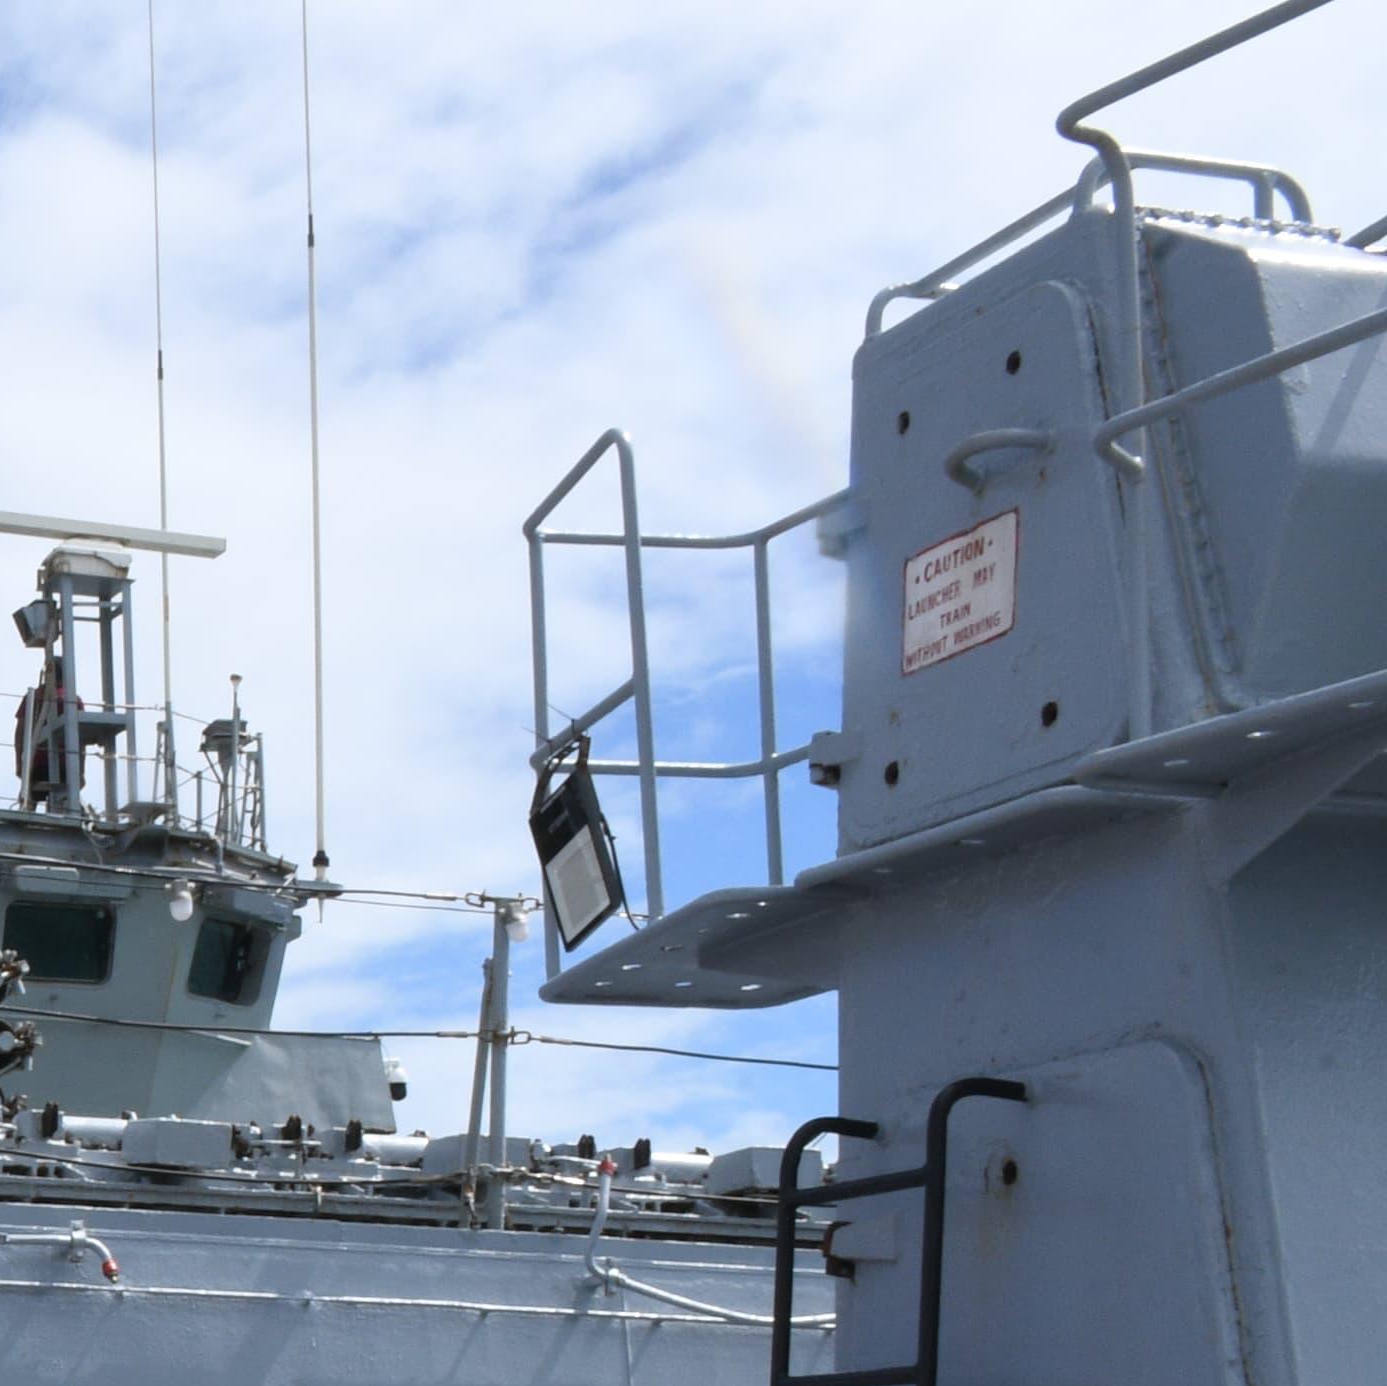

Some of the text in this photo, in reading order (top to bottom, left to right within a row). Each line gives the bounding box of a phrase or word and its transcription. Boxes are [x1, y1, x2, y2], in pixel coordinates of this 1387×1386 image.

[924, 536, 985, 583] CAUTION
[908, 562, 996, 620] LAUNCHER MAY
[940, 601, 972, 629] TRAIN
